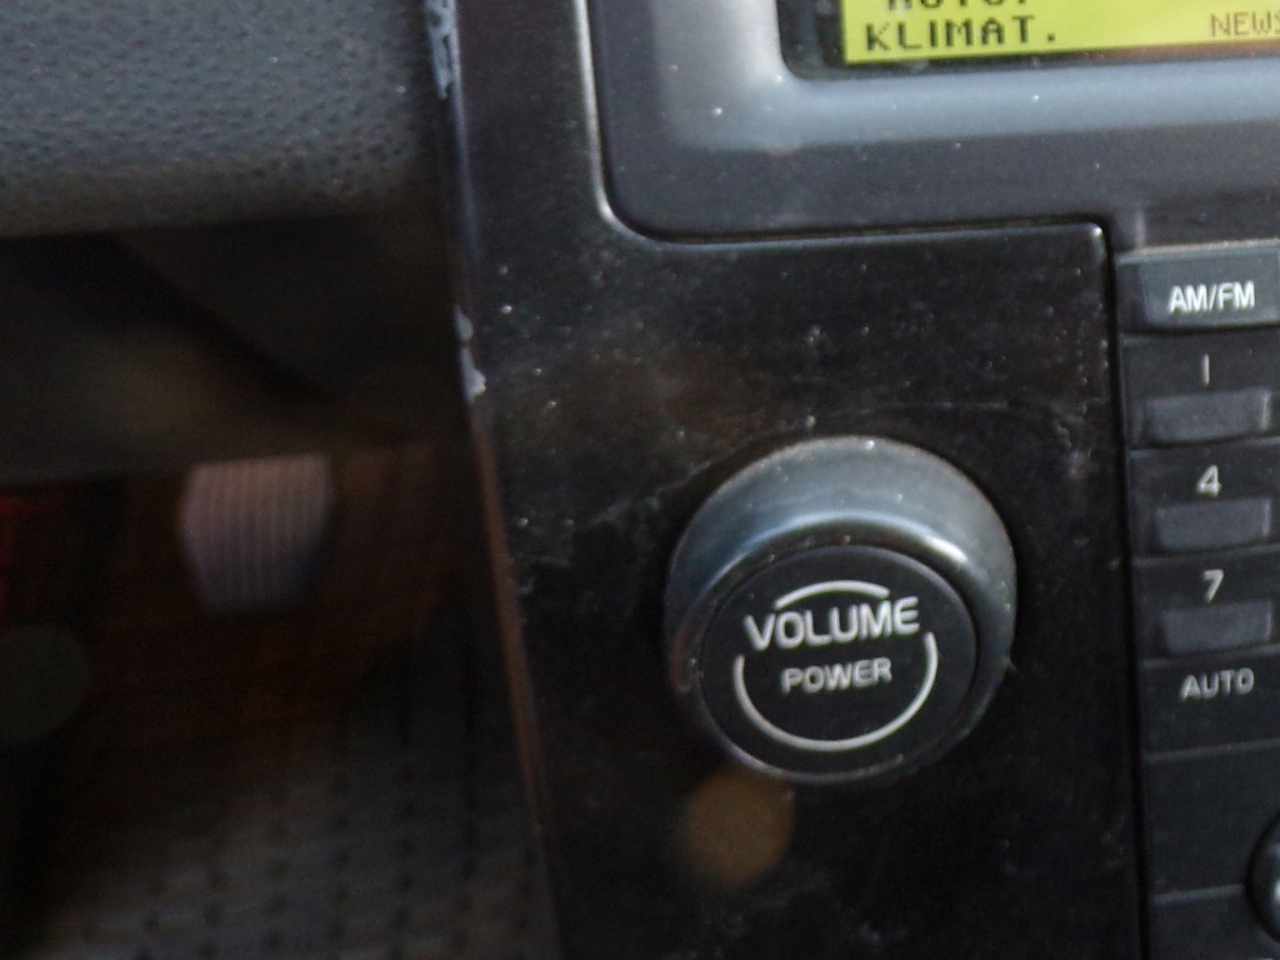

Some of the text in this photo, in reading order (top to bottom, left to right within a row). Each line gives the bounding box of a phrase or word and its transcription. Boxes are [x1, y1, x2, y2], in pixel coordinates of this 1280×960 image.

[866, 15, 1057, 52] KLIMAT.
[1168, 280, 1256, 314] AM/FM
[1196, 464, 1222, 498] 4
[1202, 569, 1225, 603] 7
[744, 596, 920, 652] VOLUME
[780, 656, 894, 696] POWER
[1180, 667, 1255, 702] AUTO
